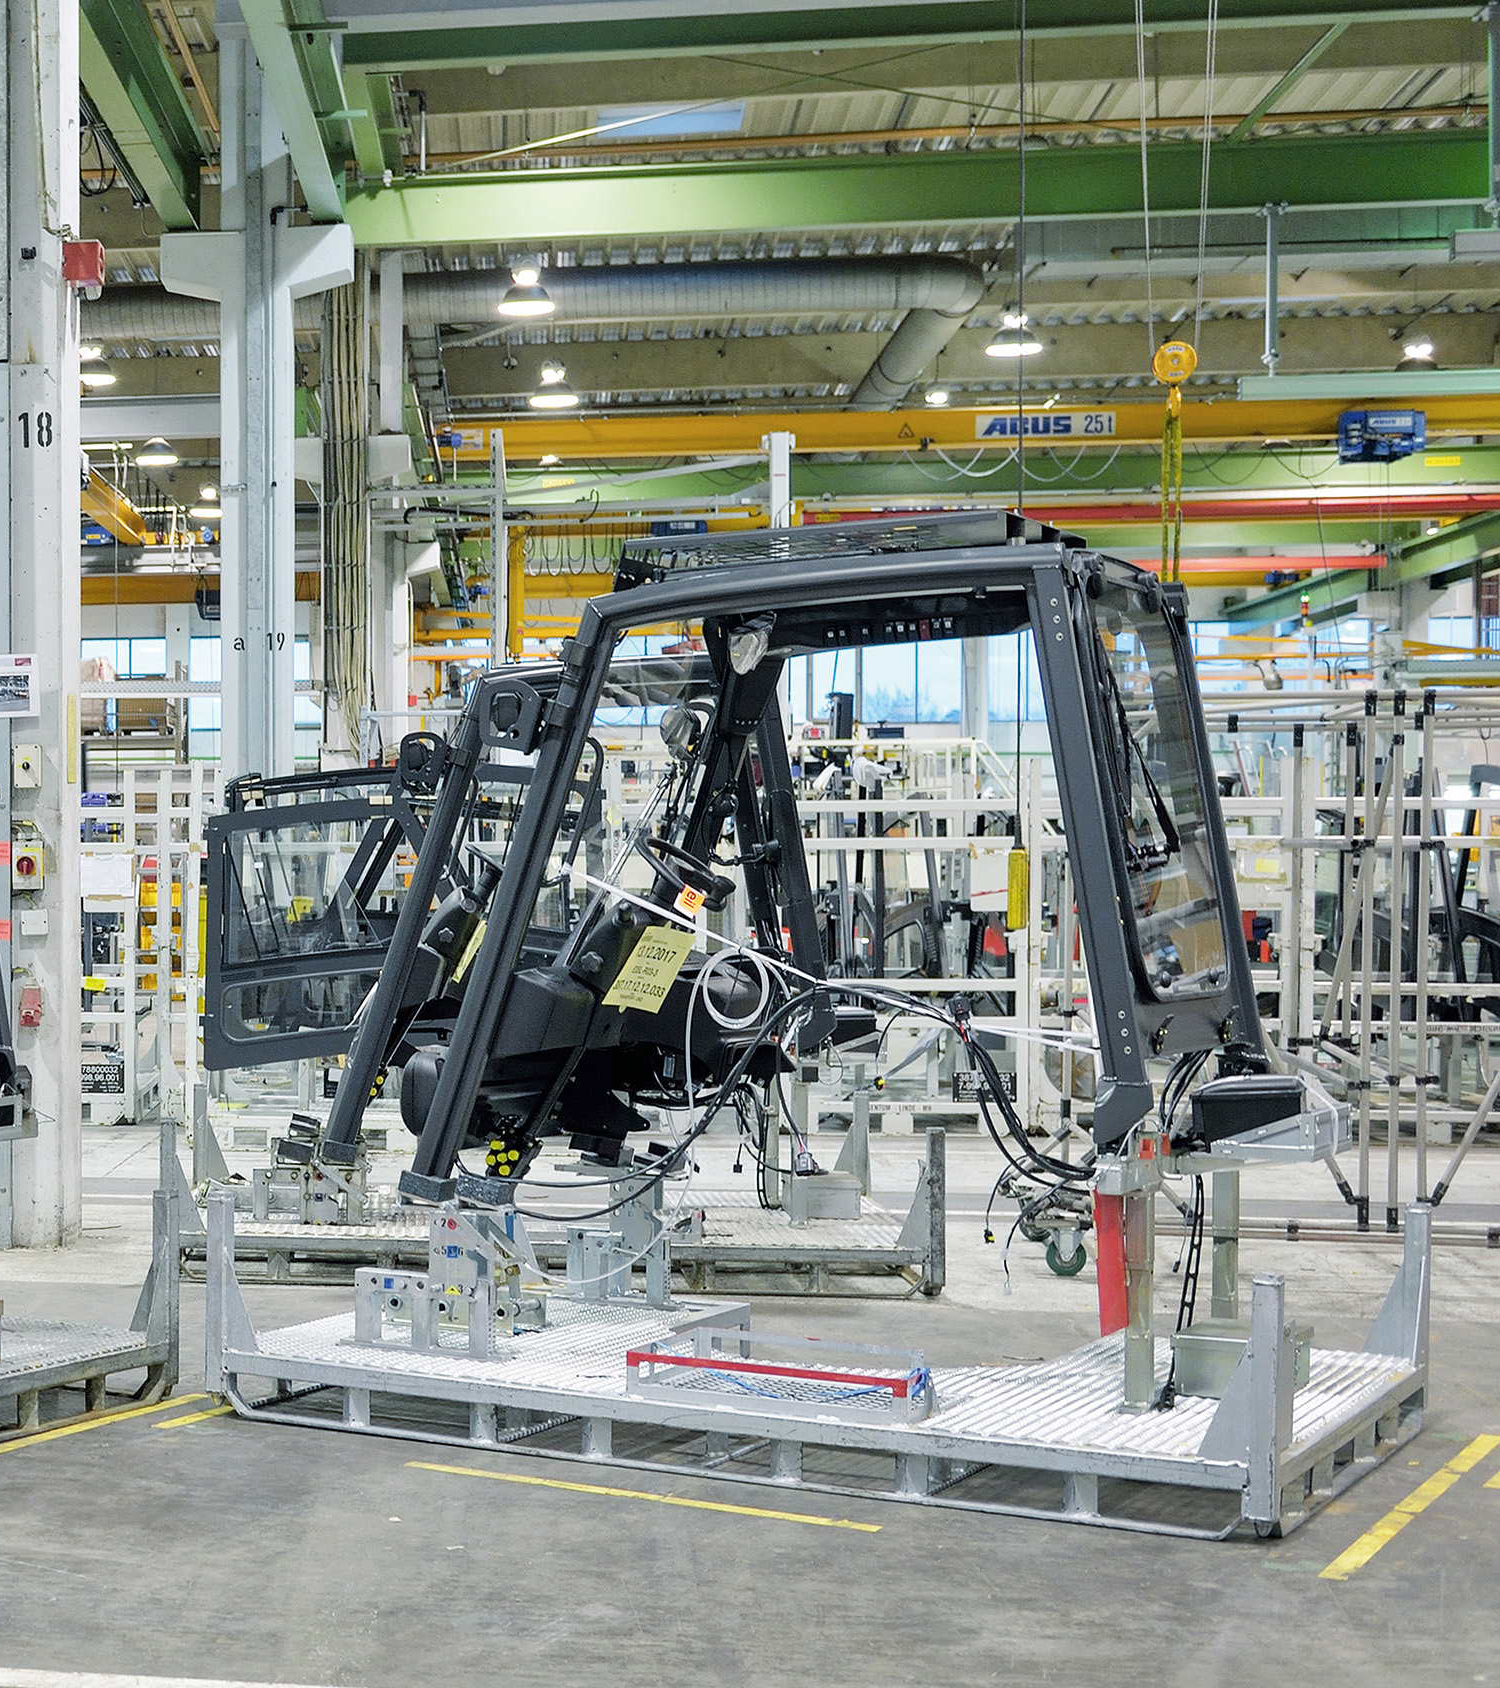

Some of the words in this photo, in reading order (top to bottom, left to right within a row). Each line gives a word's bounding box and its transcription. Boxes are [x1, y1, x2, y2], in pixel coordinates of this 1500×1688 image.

[18, 411, 53, 448] 18
[982, 415, 1072, 436] ABUS
[233, 637, 245, 651] a
[266, 632, 285, 651] 19
